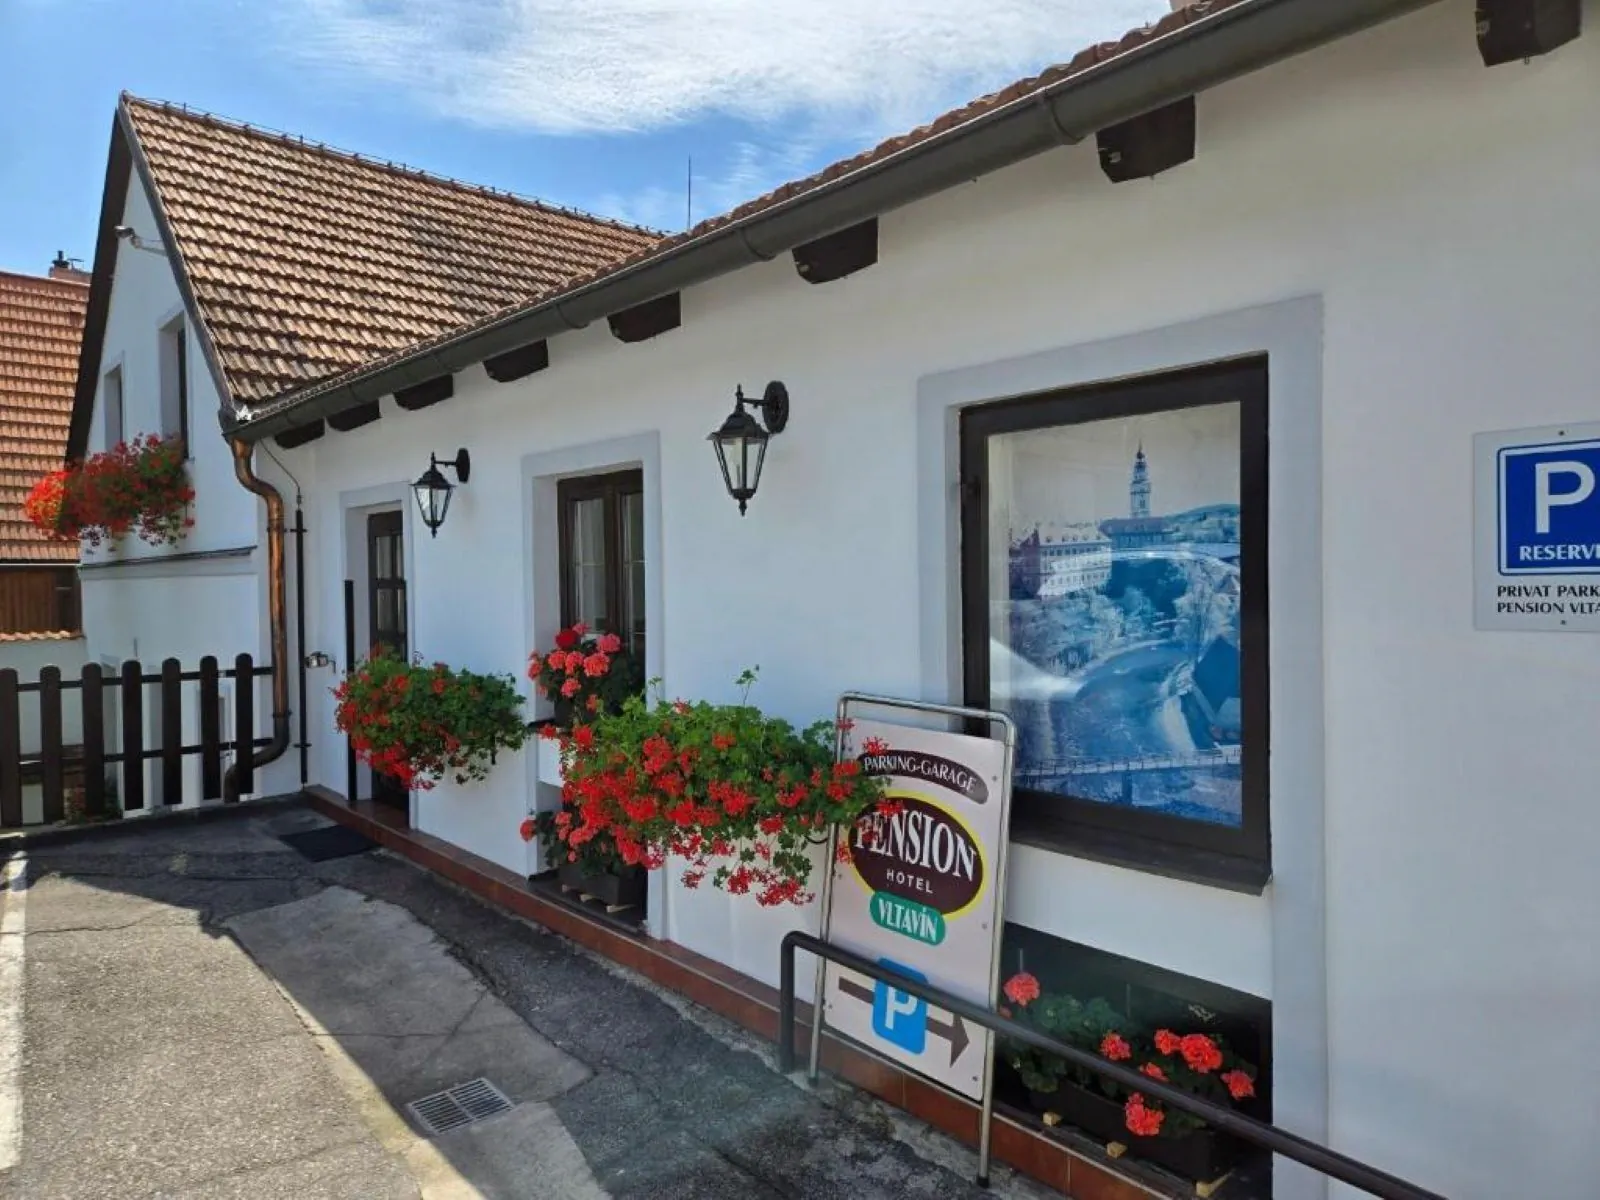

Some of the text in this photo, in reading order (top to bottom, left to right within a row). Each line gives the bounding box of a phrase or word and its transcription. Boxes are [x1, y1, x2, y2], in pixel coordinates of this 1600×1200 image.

[1534, 460, 1596, 535] P
[1496, 584, 1551, 598] PRIVAT
[1497, 601, 1565, 614] PENSION
[863, 755, 978, 794] PARKING-GARAGE
[853, 809, 977, 882] PENSION
[886, 868, 934, 894] HOTEL
[878, 898, 939, 942] VLTAVÍN
[884, 986, 919, 1031] P
